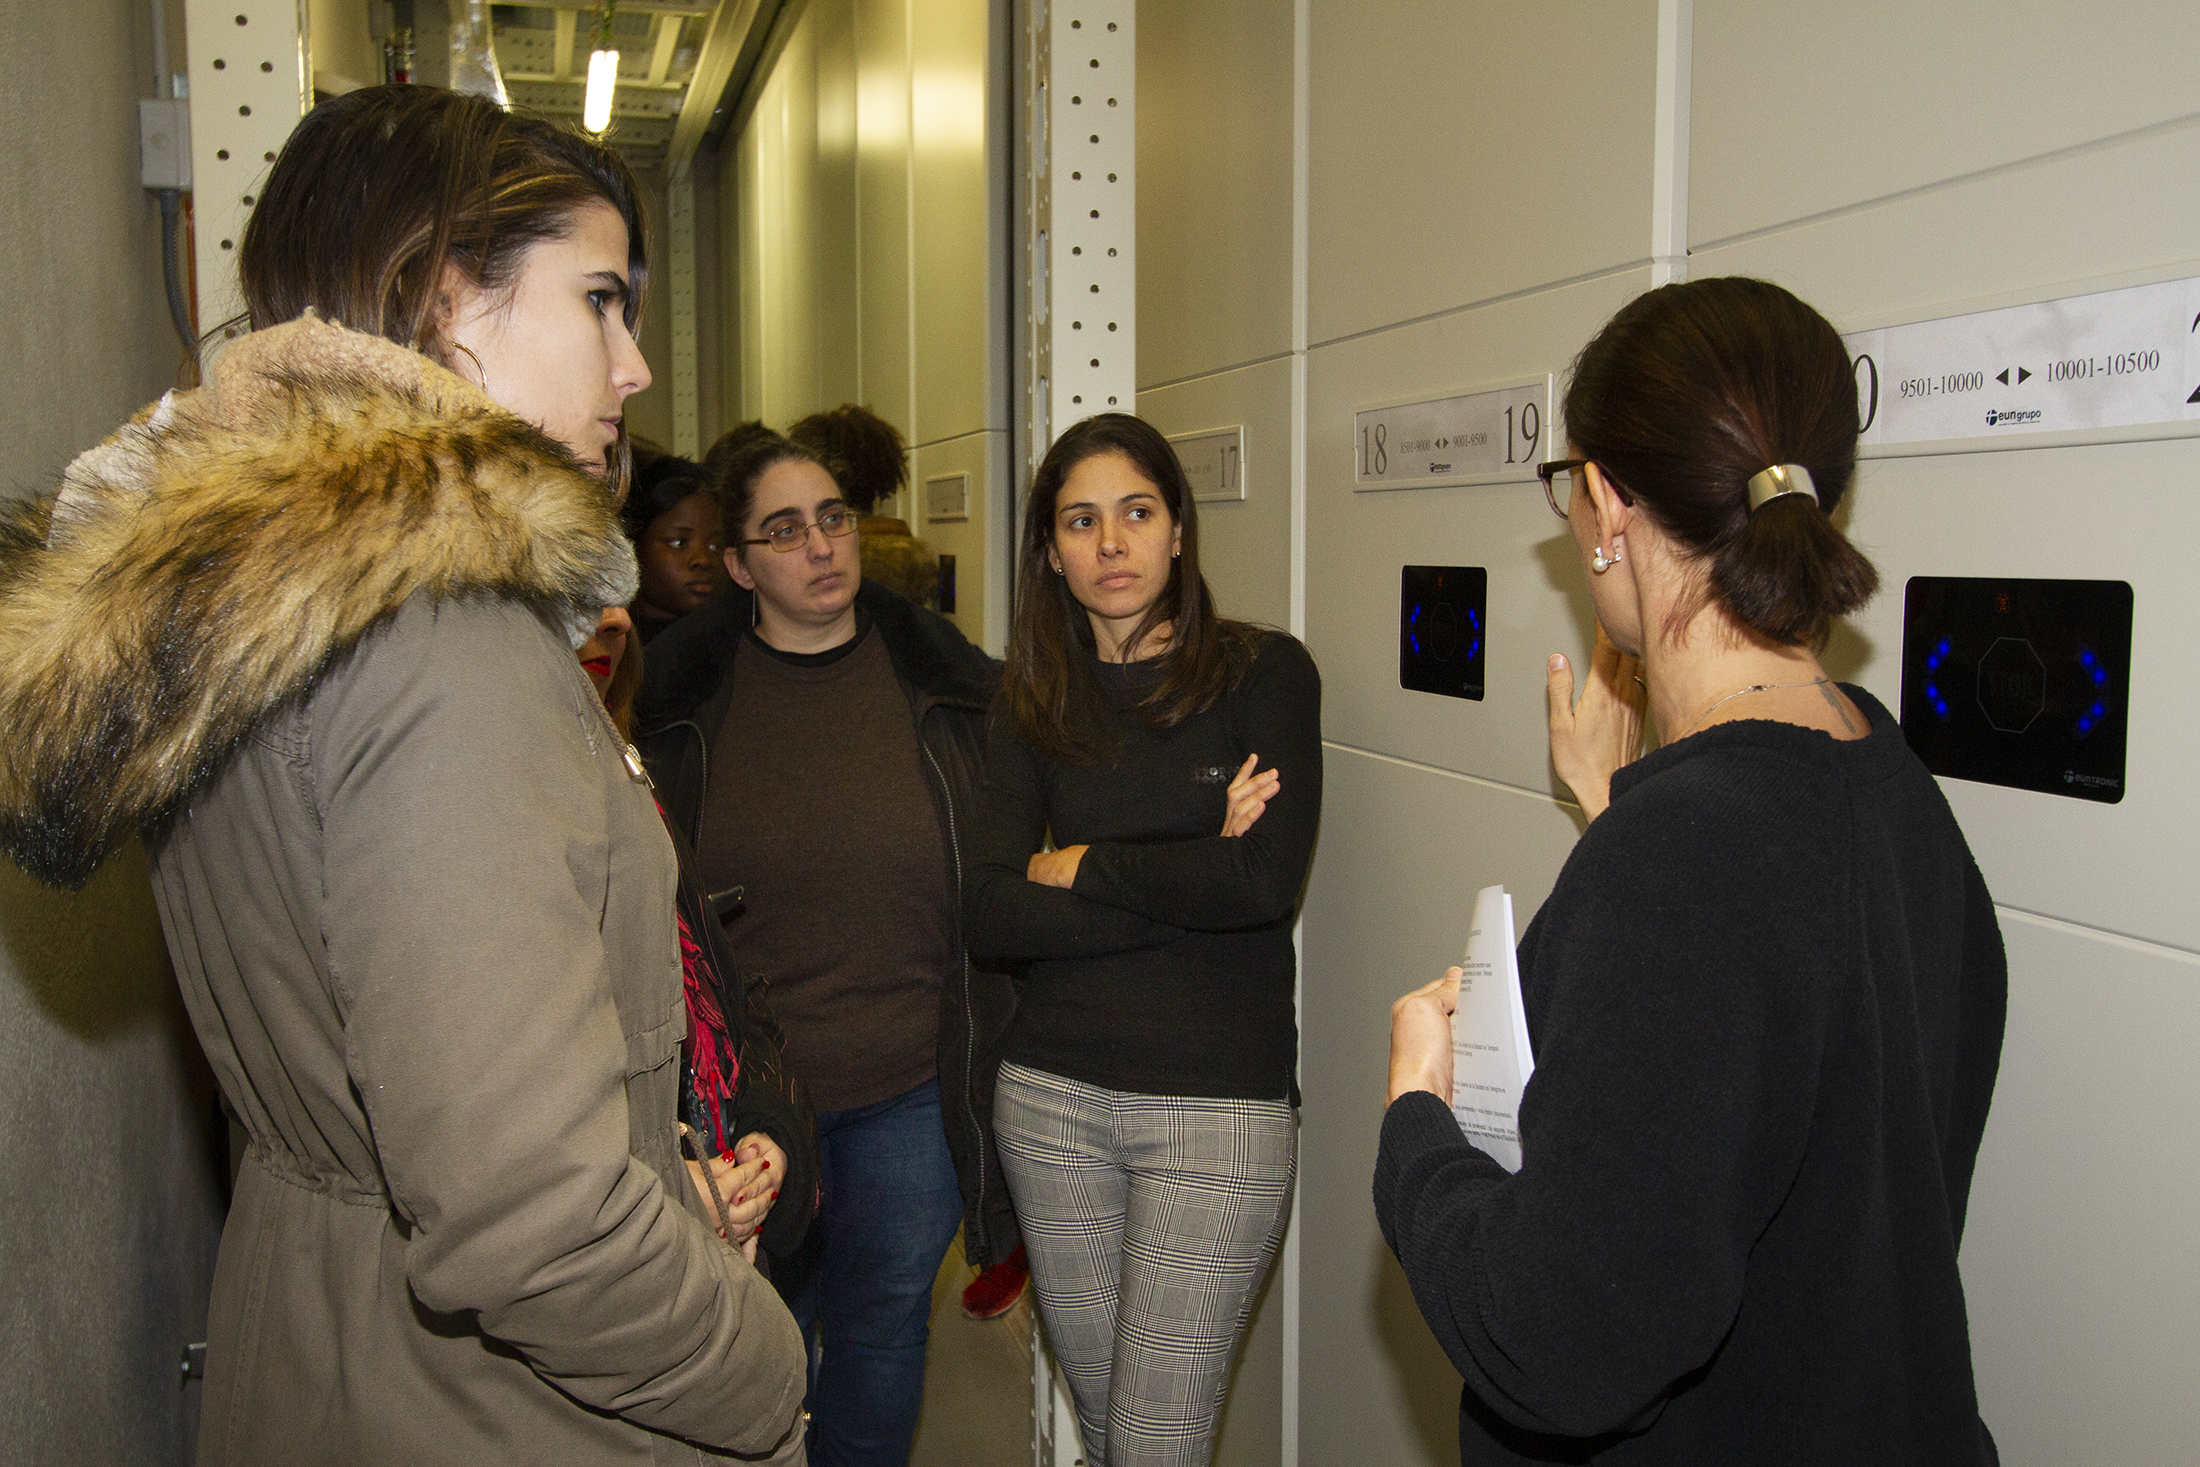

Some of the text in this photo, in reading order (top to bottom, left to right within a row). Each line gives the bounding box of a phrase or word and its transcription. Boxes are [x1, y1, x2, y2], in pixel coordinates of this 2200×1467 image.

[1899, 370, 1984, 399] 9501-10000
[2046, 349, 2161, 383] 10001-10500
[1362, 423, 1388, 476] 18
[1504, 402, 1540, 464] 19
[1220, 446, 1238, 488] 17
